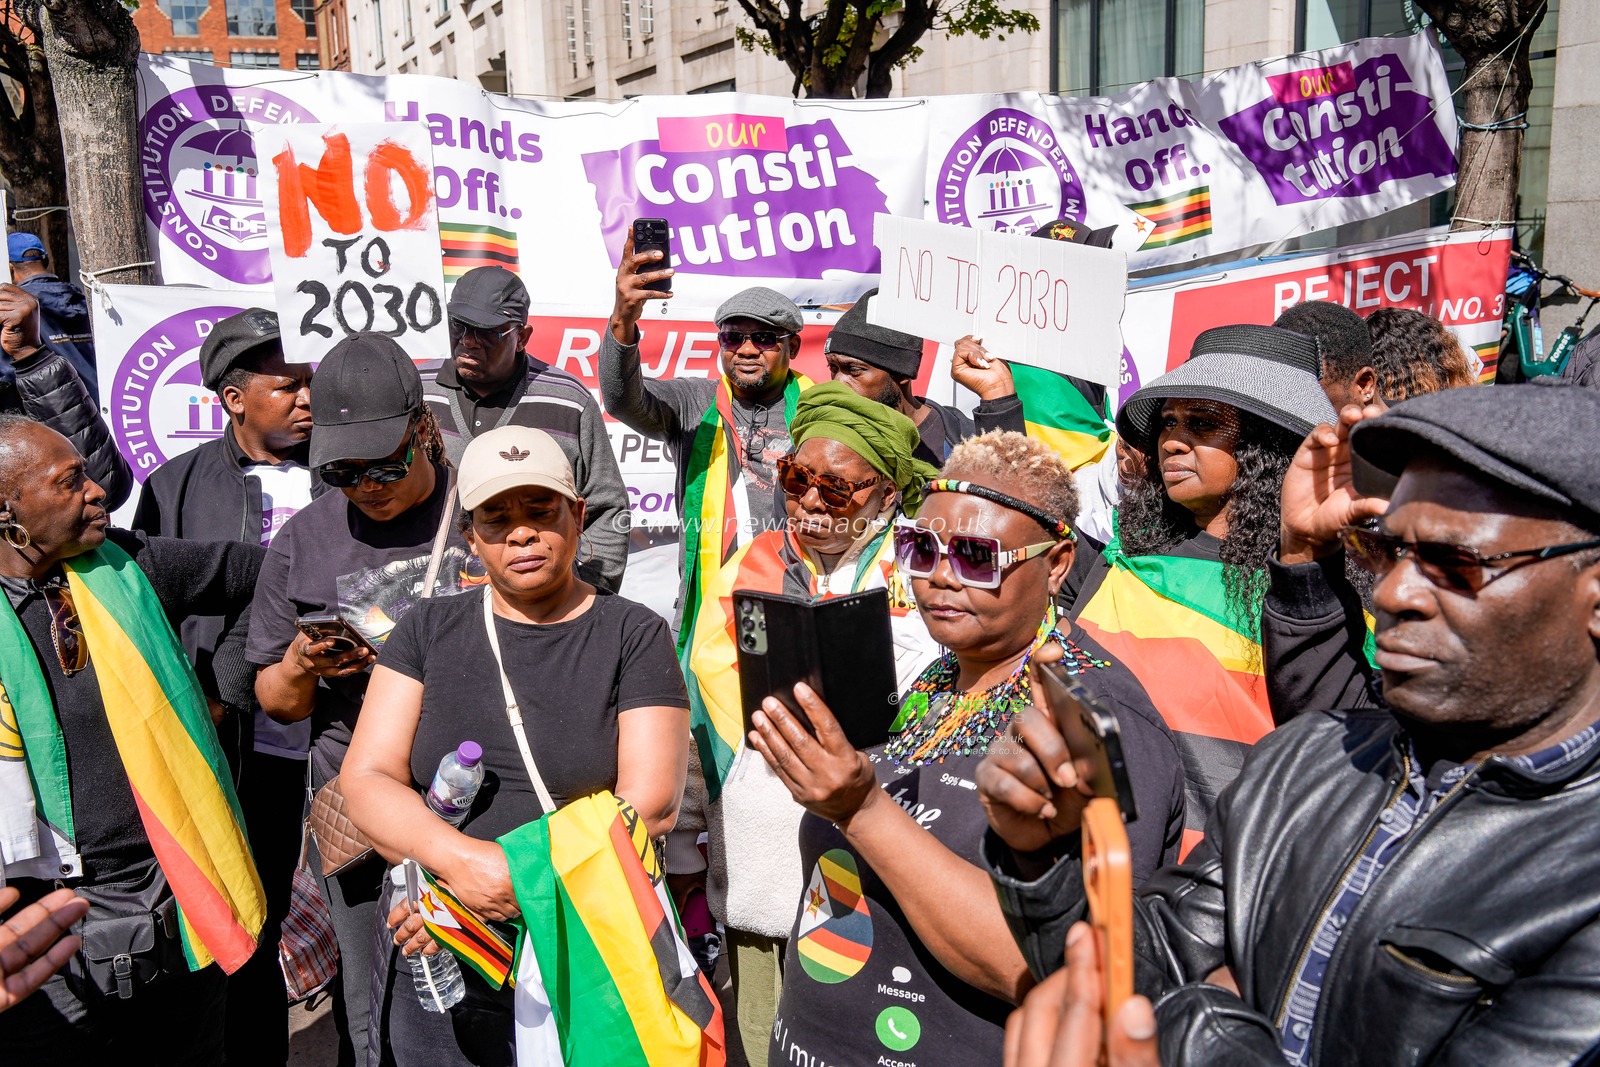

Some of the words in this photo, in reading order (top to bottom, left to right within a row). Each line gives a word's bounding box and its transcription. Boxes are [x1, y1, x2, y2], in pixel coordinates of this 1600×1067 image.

[1262, 65, 1413, 151] Consti-
[1300, 72, 1334, 98] our
[705, 122, 767, 148] our
[989, 117, 1073, 184] DEFENDERS
[1283, 126, 1403, 197] tution
[143, 102, 218, 261] CONSTITUTION
[271, 124, 435, 258] NO
[634, 134, 853, 205] Consti-
[1125, 143, 1210, 191] Off..
[211, 214, 266, 233] CDF
[322, 235, 391, 278] TO
[295, 280, 442, 339] 2030
[898, 247, 933, 302] NO
[947, 256, 980, 315] TO
[996, 264, 1069, 332] 2030
[1438, 296, 1485, 322] NO.
[1492, 293, 1504, 316] 3
[1550, 334, 1571, 363] forest
[877, 984, 926, 1002] Message
